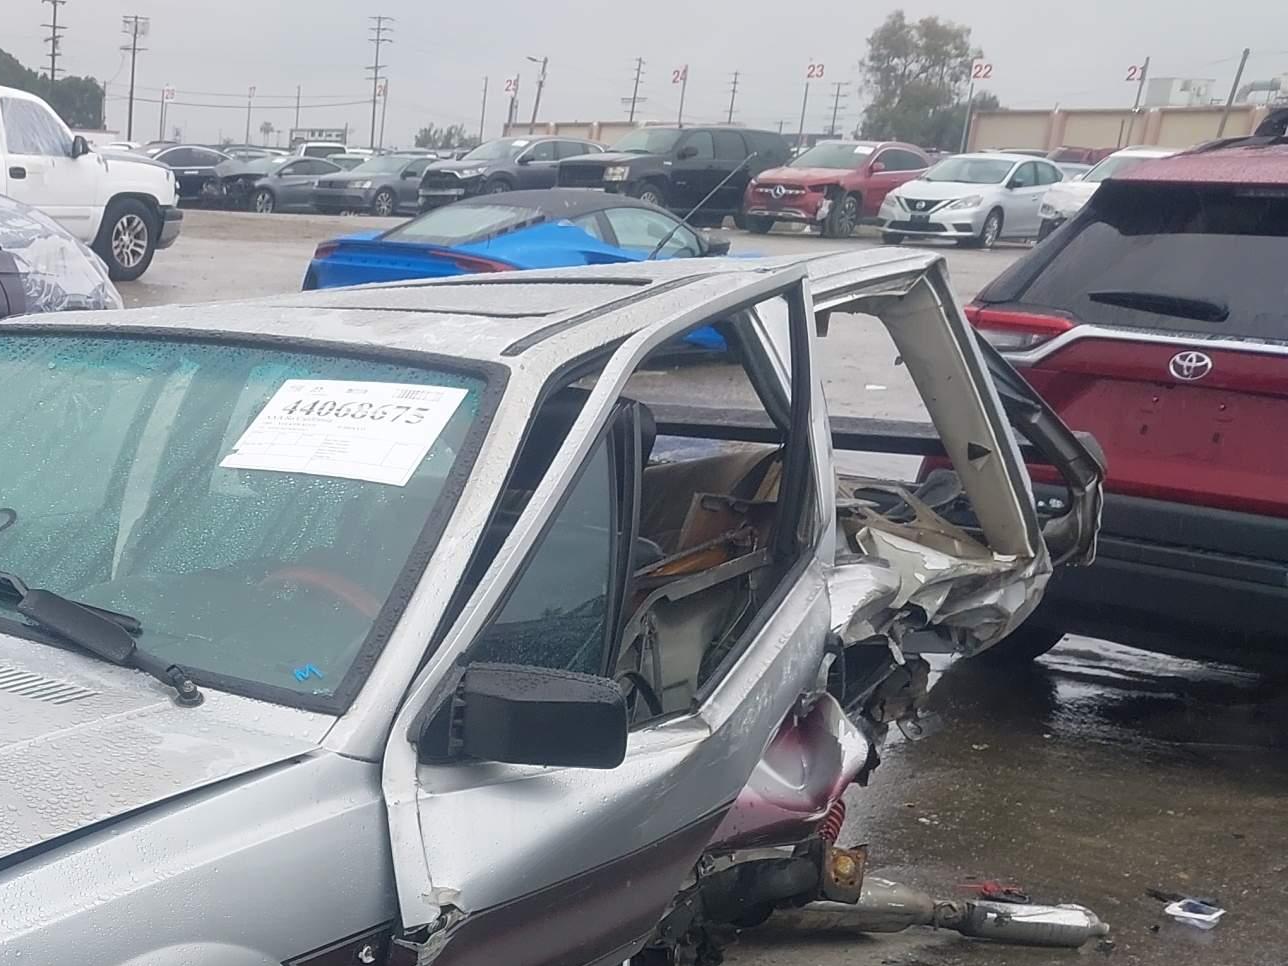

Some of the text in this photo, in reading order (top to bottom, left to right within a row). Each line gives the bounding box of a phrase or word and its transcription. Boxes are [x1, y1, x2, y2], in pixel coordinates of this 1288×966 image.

[807, 63, 825, 79] 23
[972, 63, 993, 79] 22
[281, 399, 430, 425] 44068675
